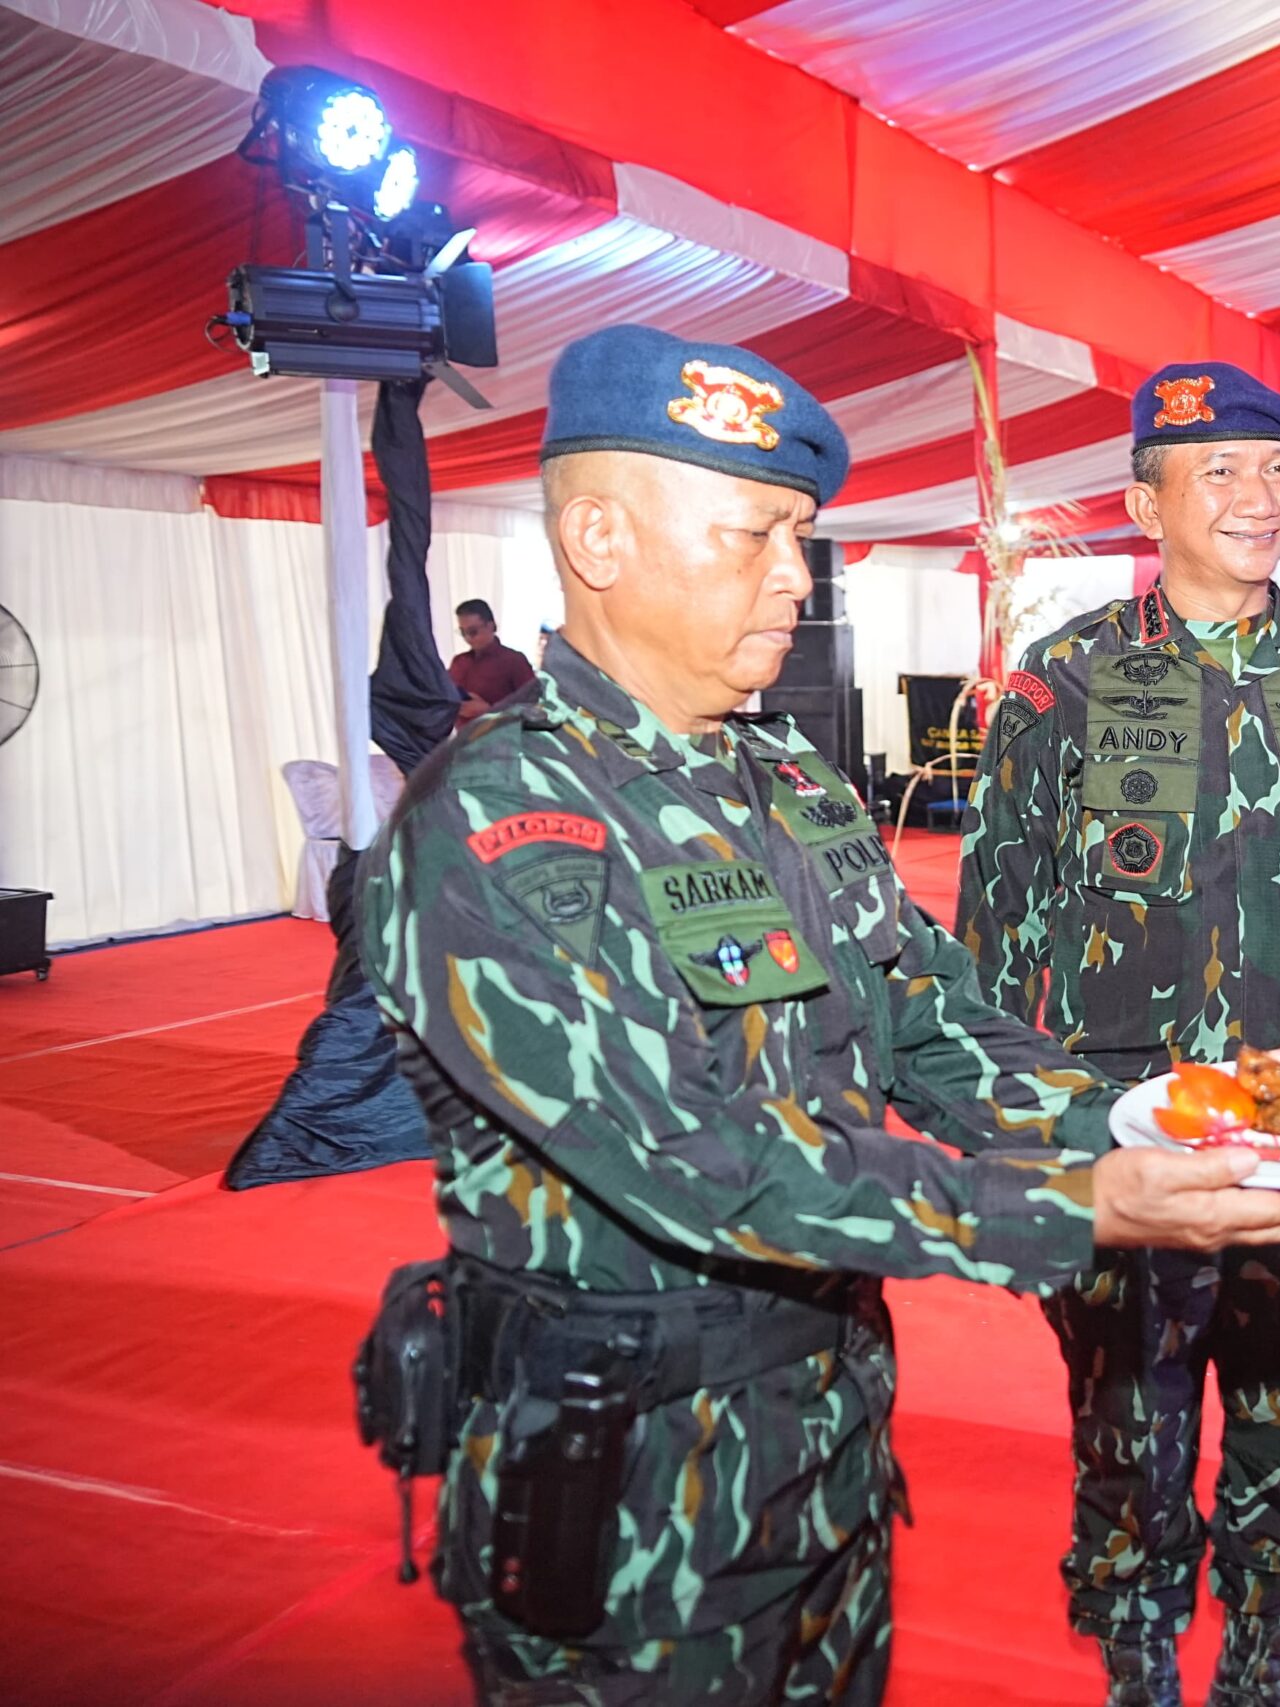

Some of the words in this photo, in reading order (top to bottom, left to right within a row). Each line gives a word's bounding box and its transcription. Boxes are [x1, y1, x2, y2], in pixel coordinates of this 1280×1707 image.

[1010, 674, 1051, 708] PELOPOR
[1099, 726, 1188, 753] ANDY
[479, 818, 597, 852] PELOPOR
[663, 867, 773, 913] SARKAM
